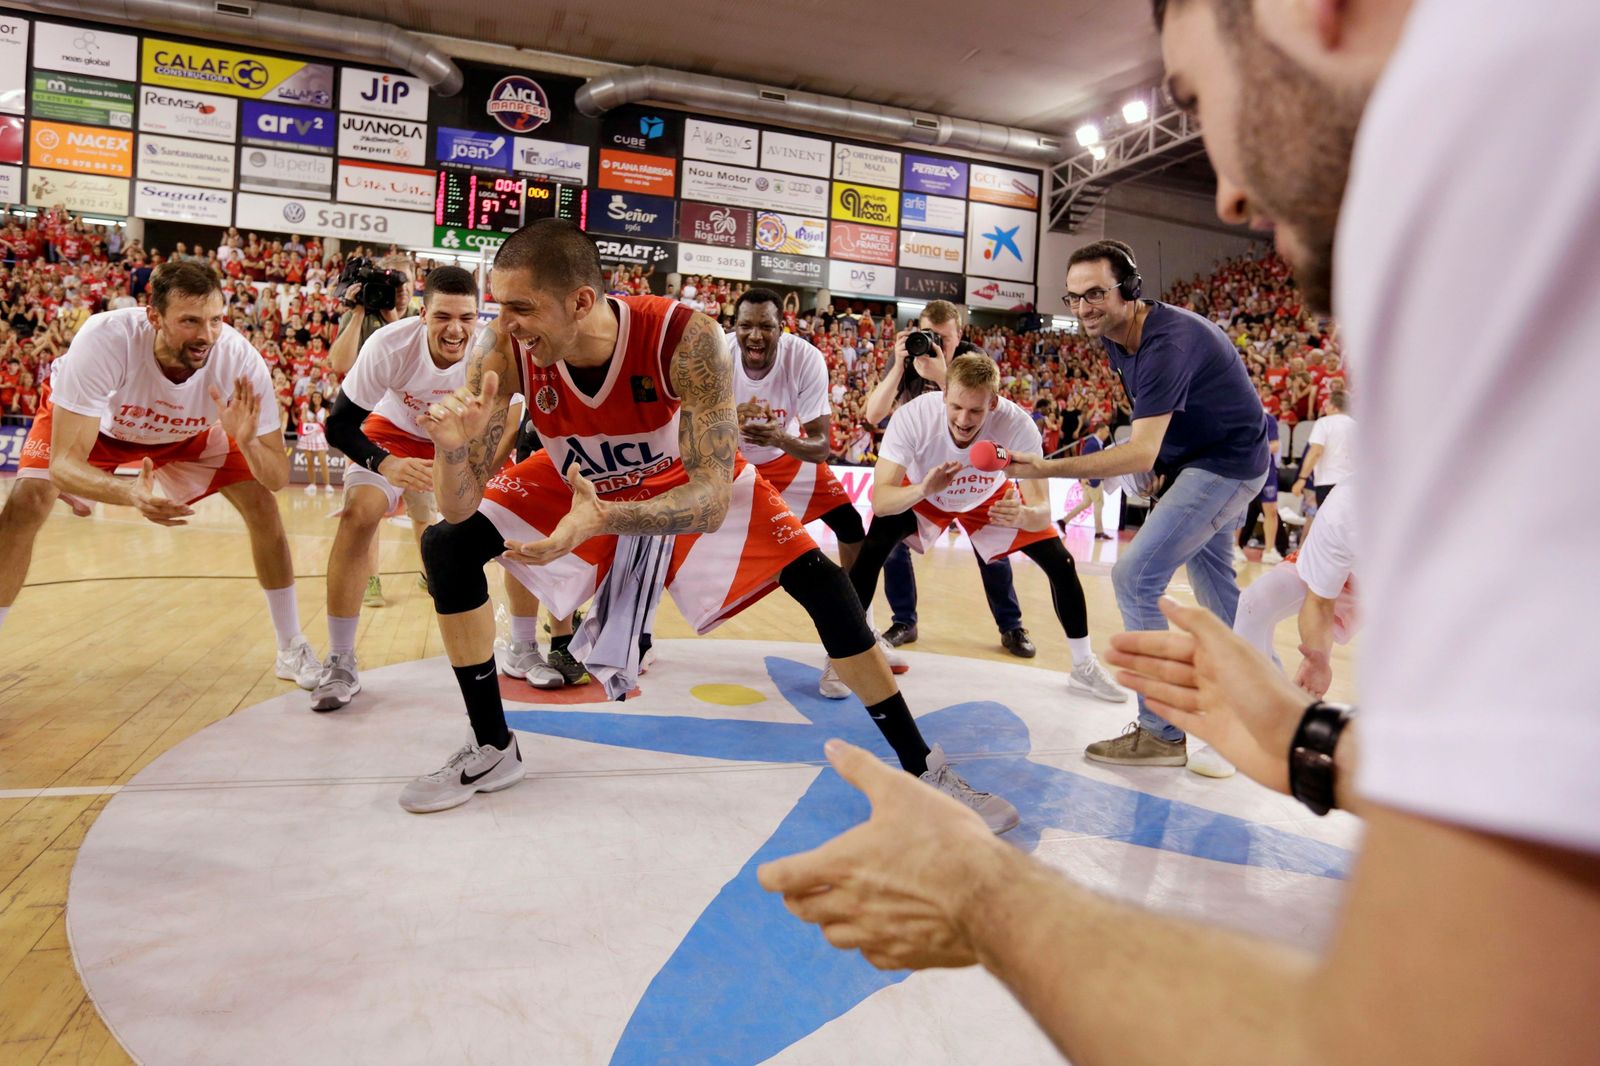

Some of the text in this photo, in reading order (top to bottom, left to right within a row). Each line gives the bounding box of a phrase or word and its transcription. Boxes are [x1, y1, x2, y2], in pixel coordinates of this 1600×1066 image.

[154, 51, 230, 74] CALAF
[155, 66, 231, 83] CONSTRUCTORA
[144, 91, 206, 115] REMSA
[491, 100, 548, 120] MANRESA
[175, 114, 232, 131] simplifica
[342, 118, 423, 139] JUANOLA
[66, 131, 130, 152] NACEX
[353, 144, 391, 154] expert
[613, 134, 647, 147] CUBE
[765, 144, 826, 163] AVINENT
[688, 167, 753, 184] Nou Motor
[864, 162, 886, 173] MAZA
[974, 171, 997, 185] GCT
[141, 186, 228, 204] Sagalés
[478, 190, 499, 199] LOCAL
[482, 199, 500, 213] 97
[606, 195, 659, 224] Señor
[317, 209, 389, 234] sarsa
[694, 220, 712, 231] Els
[694, 229, 736, 244] Noguers
[860, 230, 891, 244] CARLES
[595, 240, 654, 259] CRAFT
[904, 242, 942, 257] suma
[717, 256, 746, 268] sarsa
[851, 269, 876, 282] DAS
[904, 276, 958, 296] LAWES
[997, 288, 1026, 300] SALLENT
[561, 436, 665, 478] AICL
